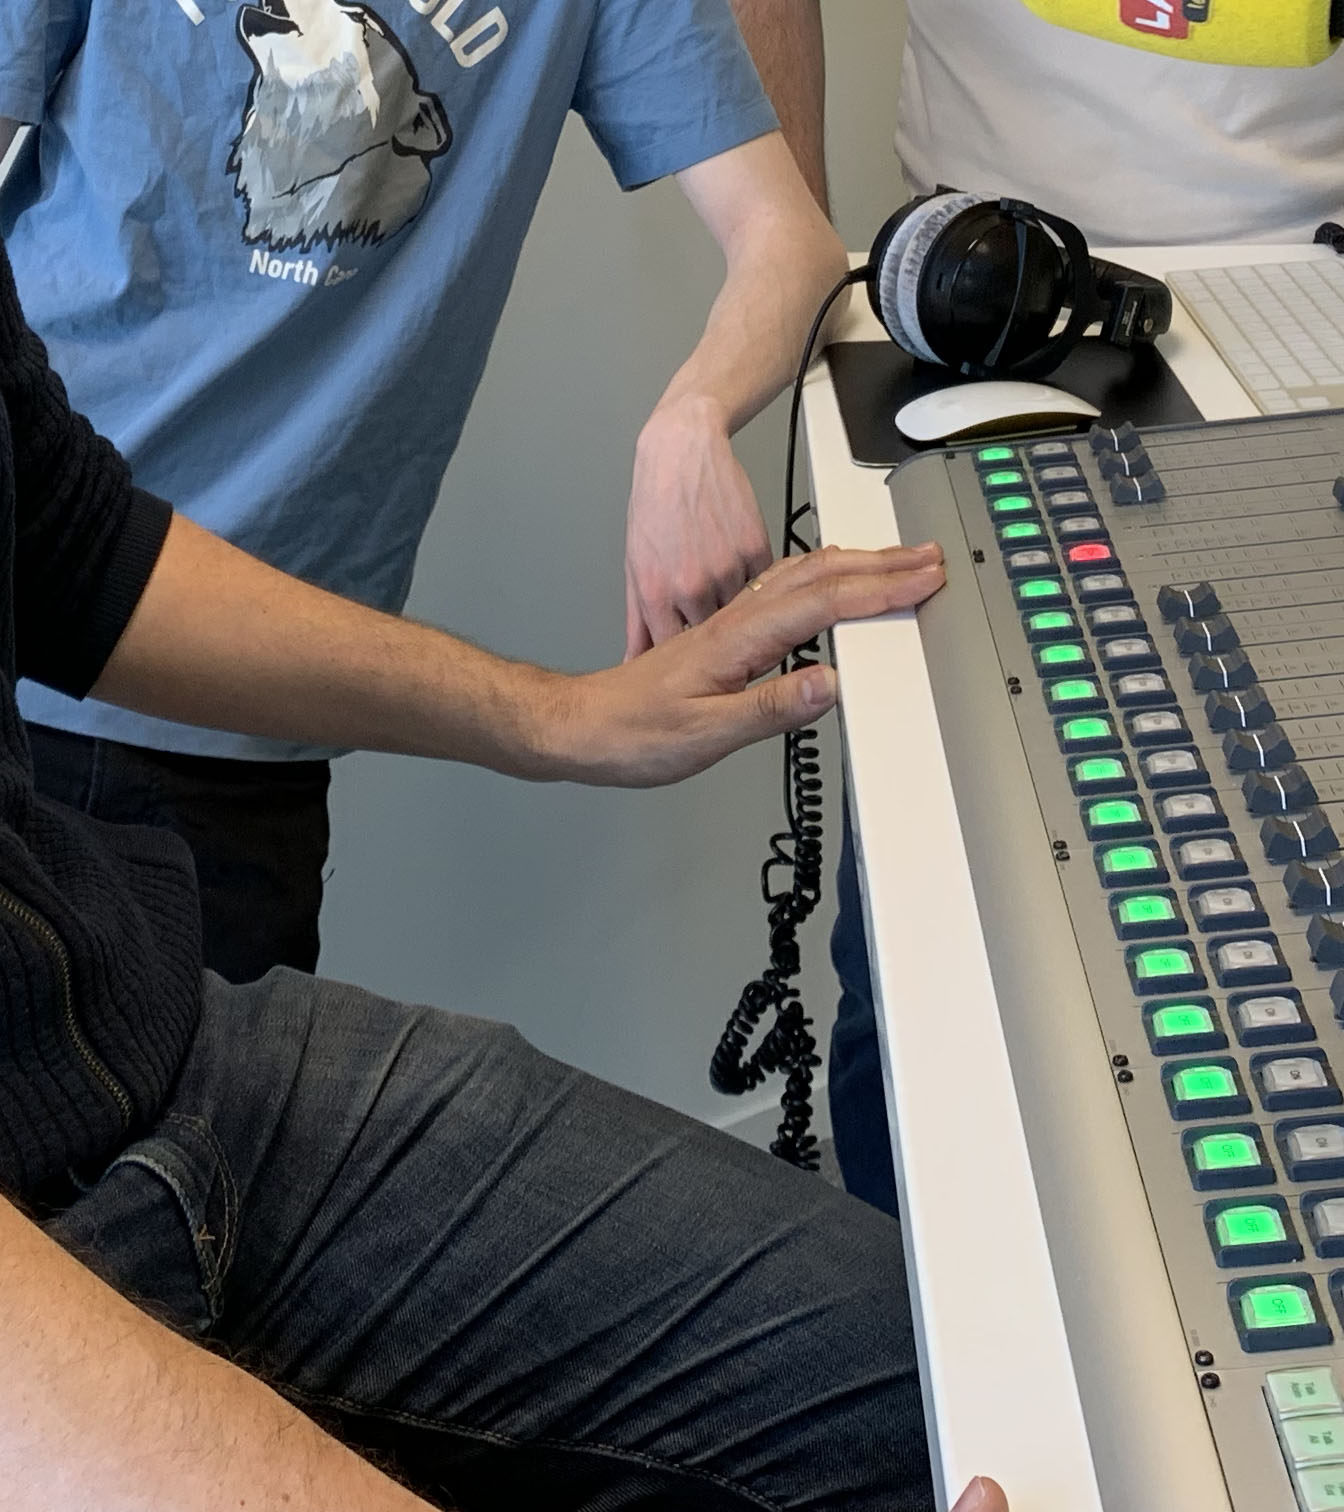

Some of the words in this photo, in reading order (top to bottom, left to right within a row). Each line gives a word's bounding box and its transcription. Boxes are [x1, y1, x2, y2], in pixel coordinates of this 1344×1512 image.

[249, 248, 319, 287] North
[1244, 1217, 1259, 1233] OFF
[1271, 1298, 1287, 1315] OFF
